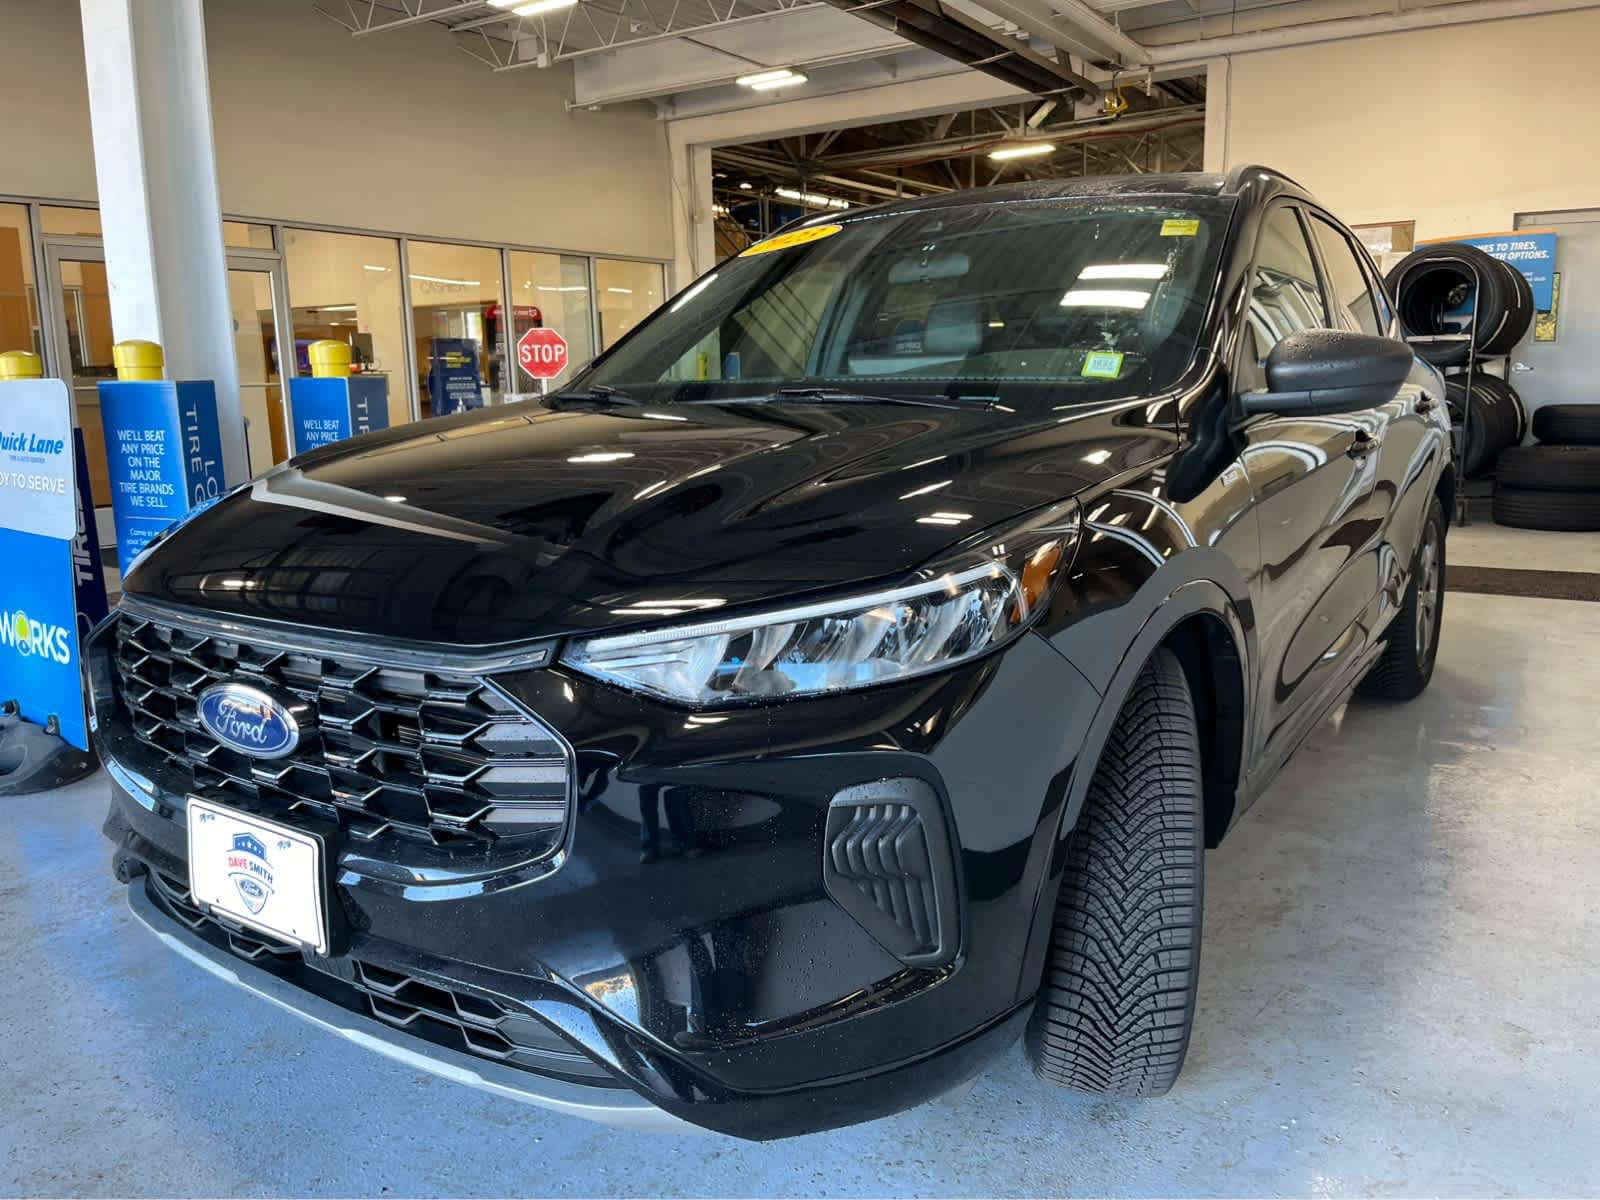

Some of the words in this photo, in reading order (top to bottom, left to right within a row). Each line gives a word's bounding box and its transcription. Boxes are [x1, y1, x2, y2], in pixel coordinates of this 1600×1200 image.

[1496, 242, 1508, 251] TO
[1510, 240, 1537, 251] TIRES,
[1507, 250, 1550, 260] OPTIONS.
[521, 344, 565, 363] STOP
[303, 419, 322, 430] WE'LL
[323, 420, 339, 430] BEAT
[117, 429, 143, 441] WE'LL
[144, 430, 165, 441] BEAT
[186, 399, 203, 472] TIRE
[306, 431, 319, 441] ANY
[321, 432, 339, 441] PRICE
[0, 432, 28, 451] uick
[29, 433, 64, 454] Lane
[121, 443, 140, 454] ANY
[141, 444, 165, 455] PRICE
[128, 456, 142, 468] ON
[143, 457, 160, 468] THE
[130, 469, 161, 481] MAJOR
[204, 460, 218, 498] LO
[11, 472, 26, 489] TO
[29, 474, 65, 494] SERVE
[119, 482, 137, 494] TIRE
[139, 484, 175, 495] BRANDS
[130, 496, 144, 507] WE
[215, 699, 270, 744] Ford
[228, 856, 247, 869] DAVE
[249, 861, 273, 884] SMITH
